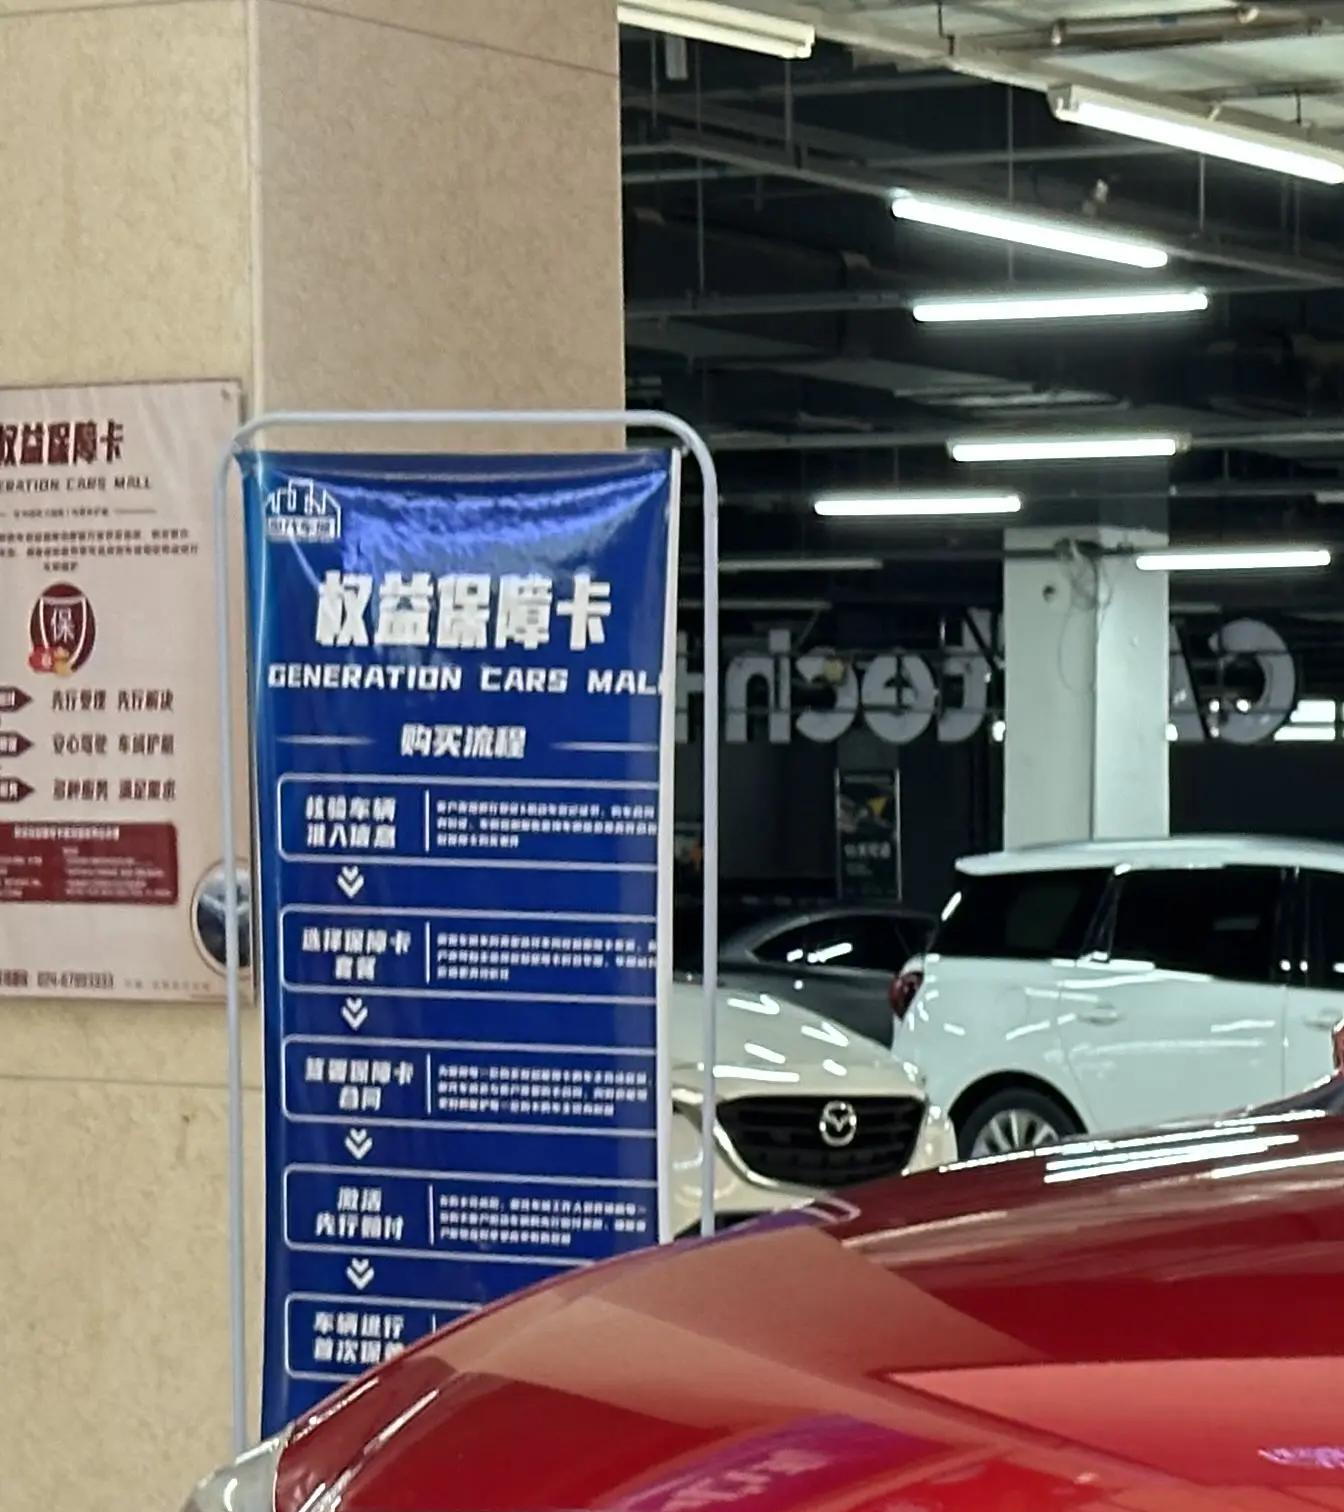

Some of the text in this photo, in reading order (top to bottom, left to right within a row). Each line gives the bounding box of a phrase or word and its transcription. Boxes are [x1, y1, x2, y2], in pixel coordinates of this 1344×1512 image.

[51, 608, 75, 642] 保
[315, 569, 612, 652] 权益保障卡
[268, 663, 662, 696] GENERATION CARS MAL
[400, 723, 527, 760] 购买流程
